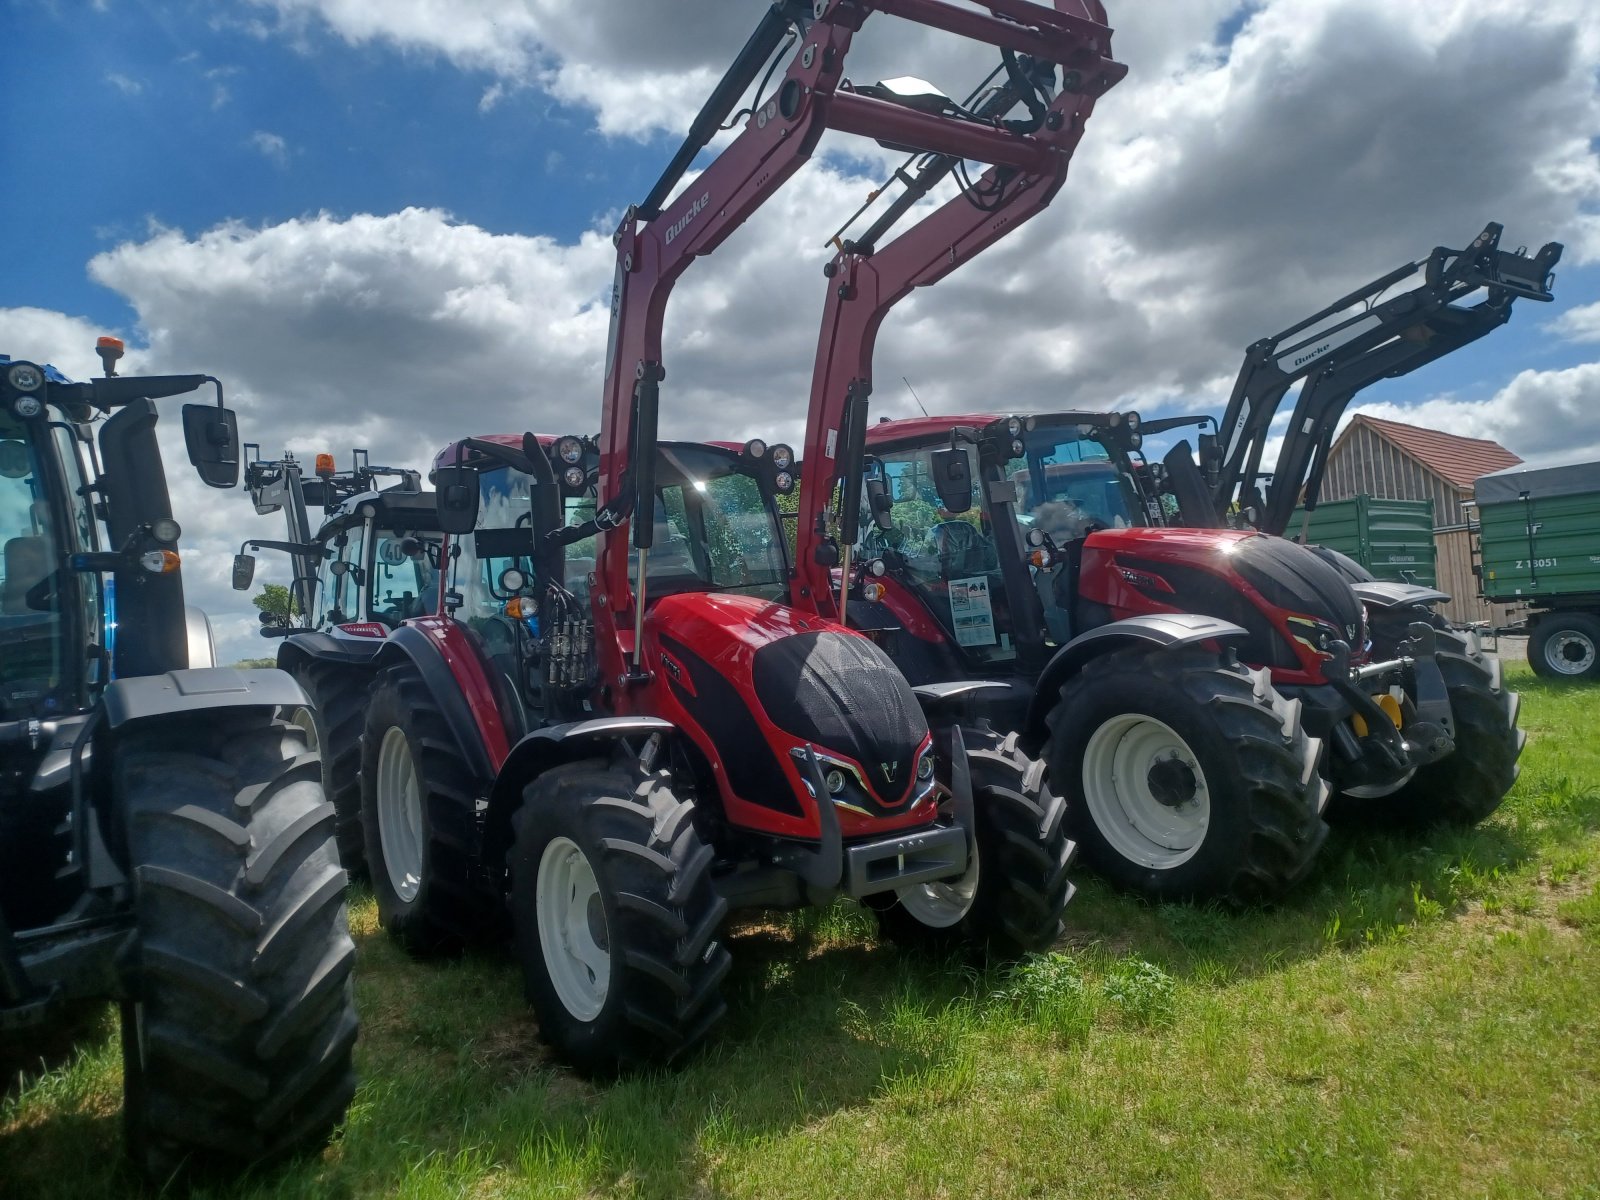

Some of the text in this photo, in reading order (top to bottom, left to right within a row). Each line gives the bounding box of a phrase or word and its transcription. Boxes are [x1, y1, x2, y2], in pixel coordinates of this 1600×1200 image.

[665, 191, 709, 245] Quicke
[1294, 344, 1330, 366] Quicke
[384, 543, 402, 561] 40
[1515, 560, 1523, 569] Z
